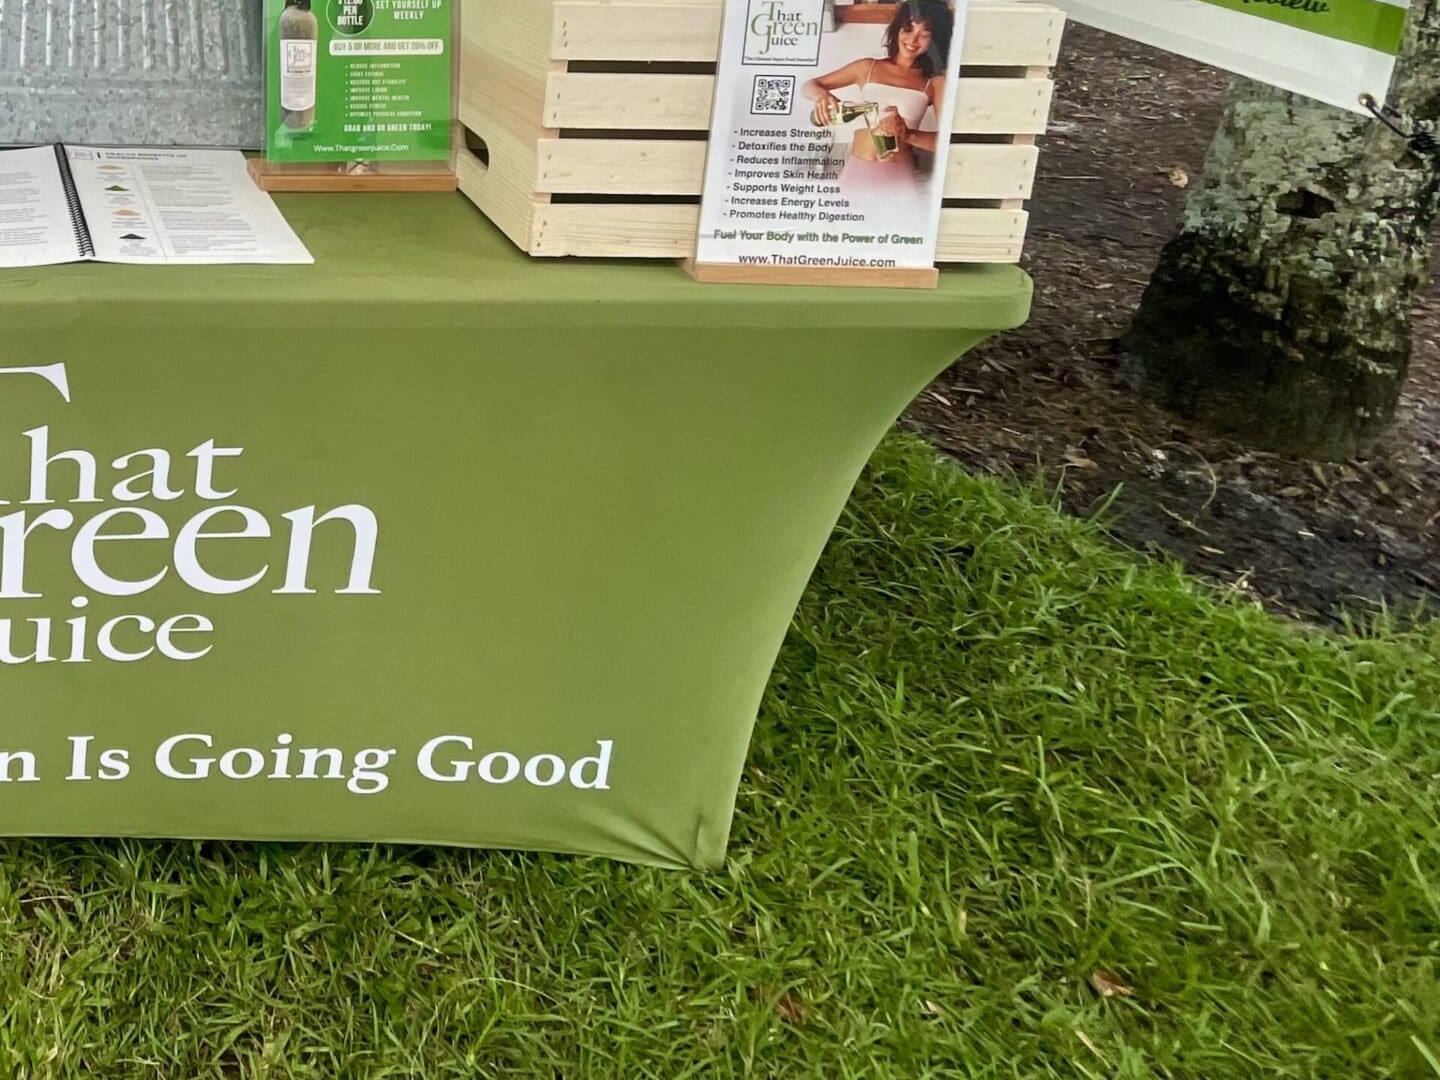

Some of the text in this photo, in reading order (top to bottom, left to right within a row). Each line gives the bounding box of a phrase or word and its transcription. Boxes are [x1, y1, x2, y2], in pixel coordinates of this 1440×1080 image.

[343, 5, 357, 15] PER
[762, 1, 800, 21] That
[337, 16, 363, 26] BOTTLE
[751, 13, 818, 36] Green
[759, 26, 798, 55] Juice
[738, 254, 896, 267] www.ThatGreenJuice.com
[65, 735, 131, 784] Is
[155, 732, 398, 792] Going
[416, 733, 615, 792] Good
